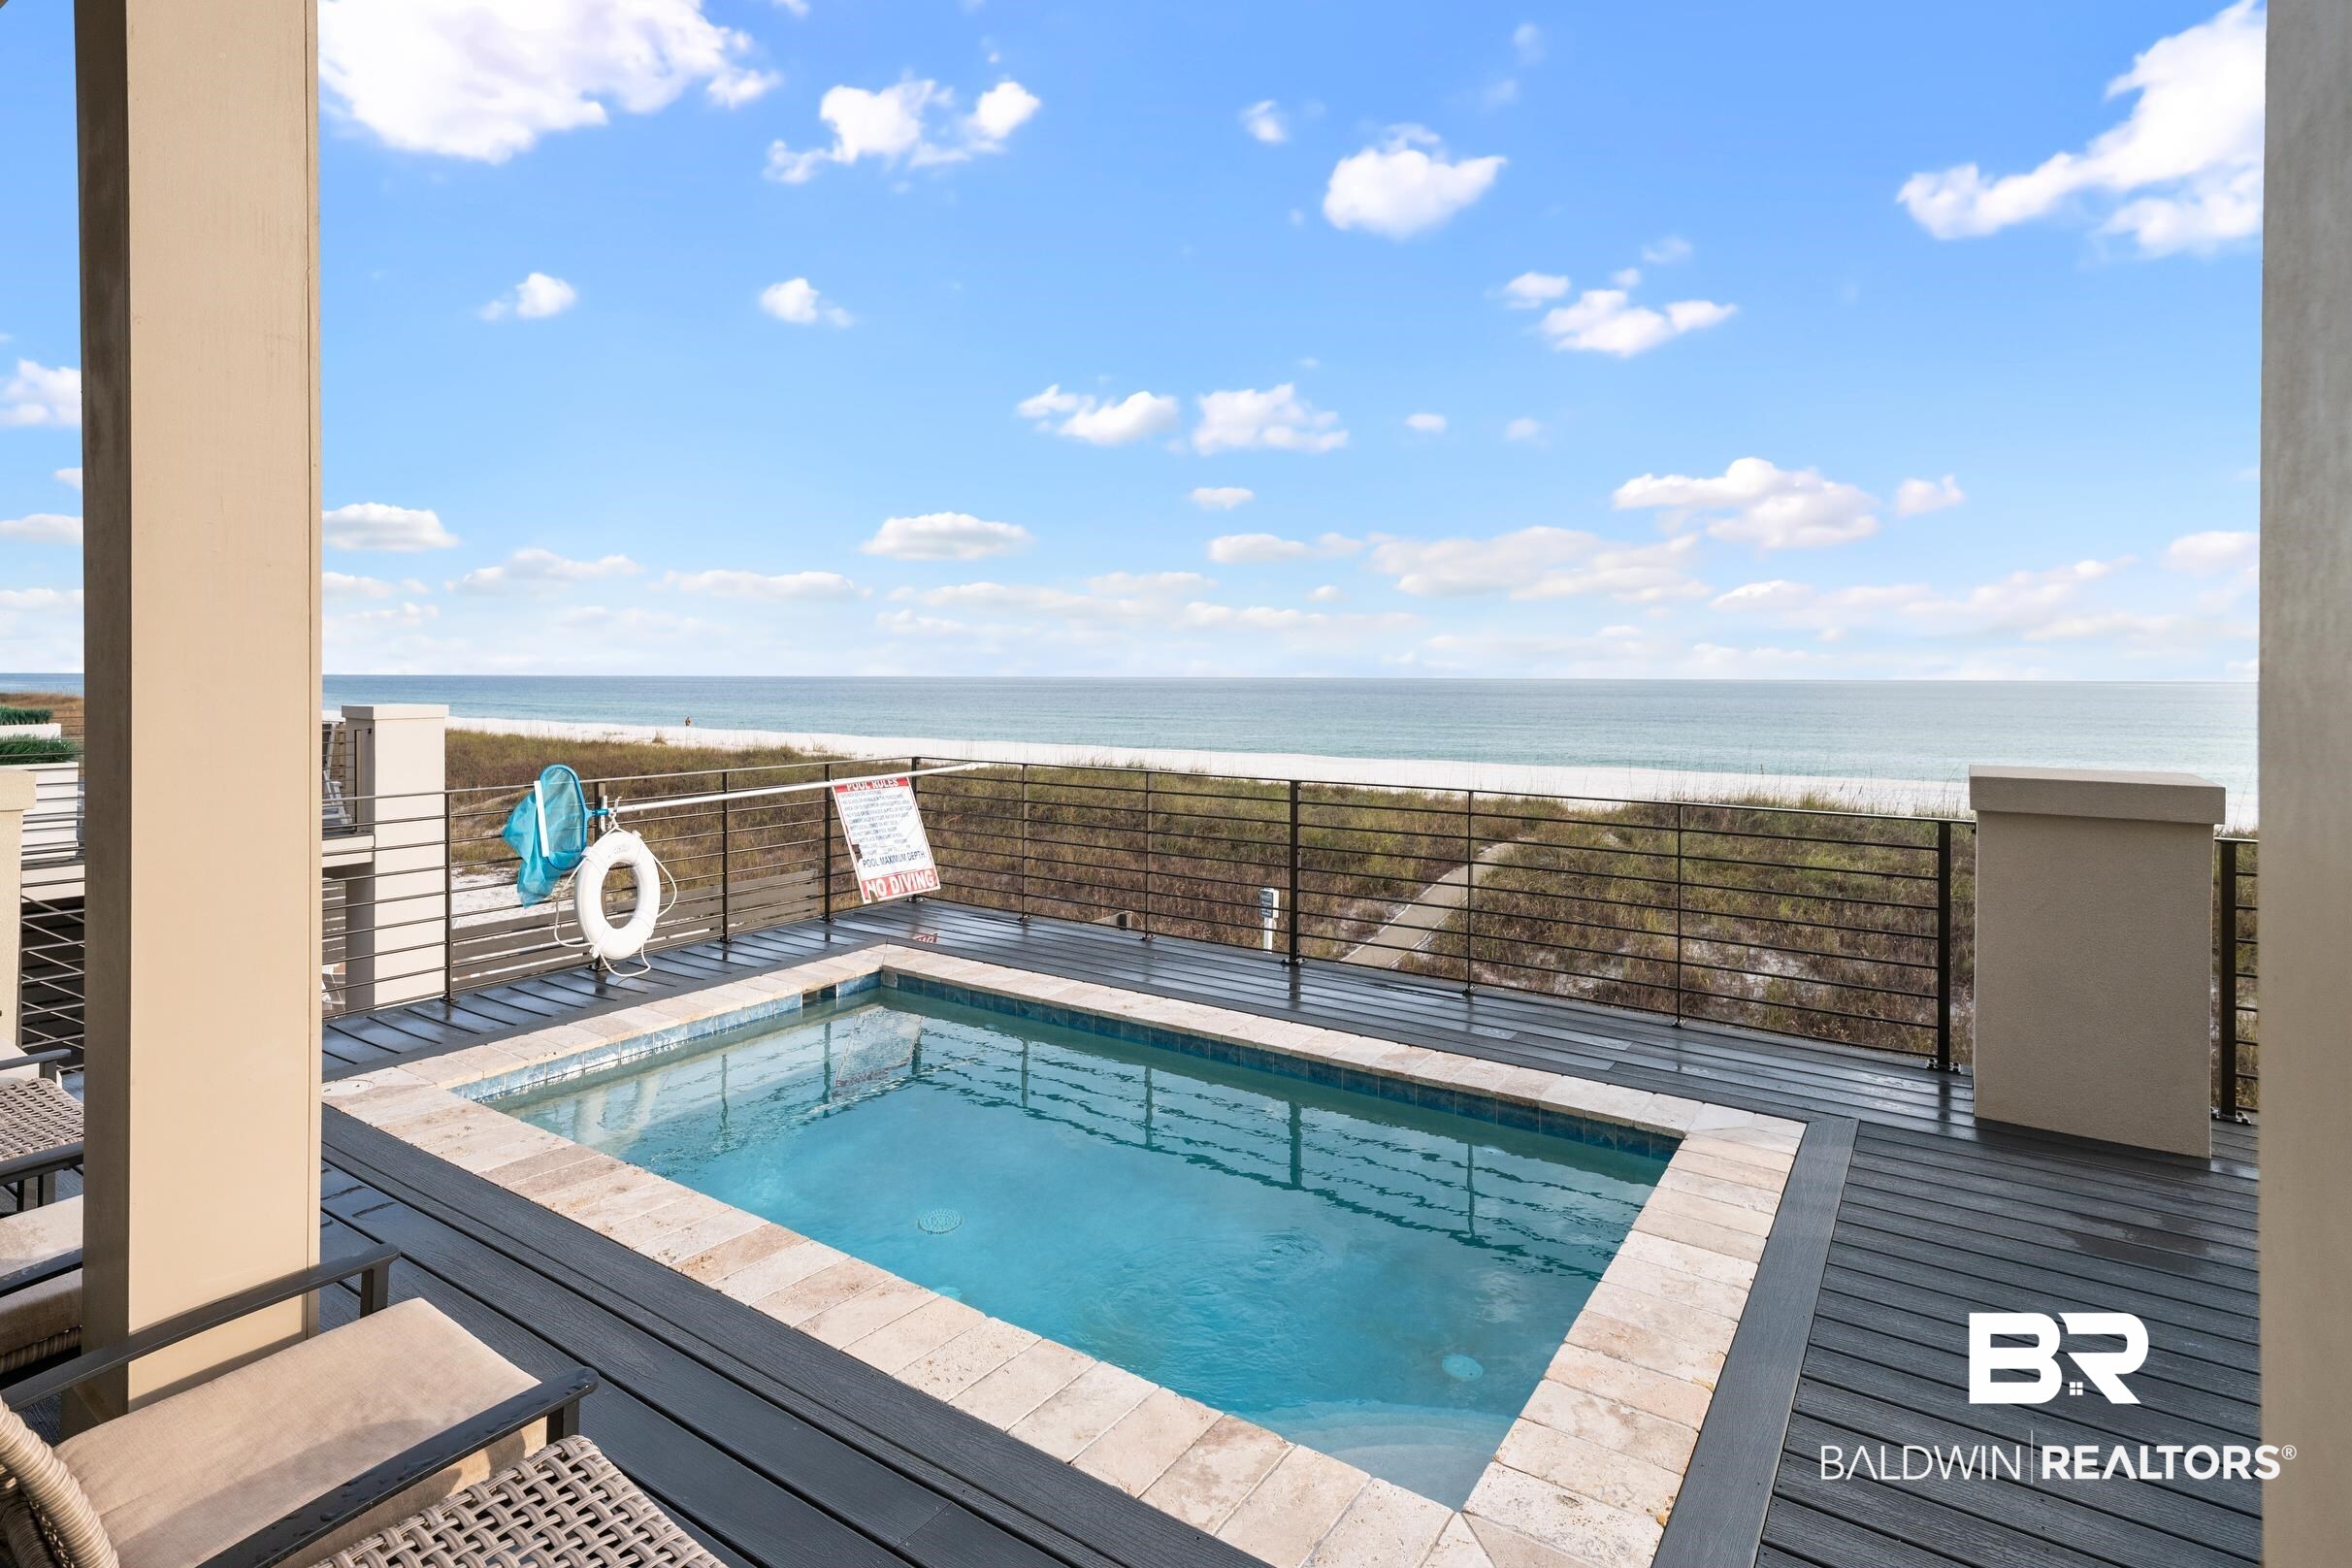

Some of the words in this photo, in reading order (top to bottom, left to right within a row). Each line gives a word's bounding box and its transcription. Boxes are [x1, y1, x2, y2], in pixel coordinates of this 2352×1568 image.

[846, 779, 870, 792] POOL
[871, 777, 898, 789] RULES
[863, 858, 879, 868] POOL
[880, 853, 906, 866] MAXIMUM
[865, 878, 888, 900] NO
[888, 869, 935, 894] DIVING
